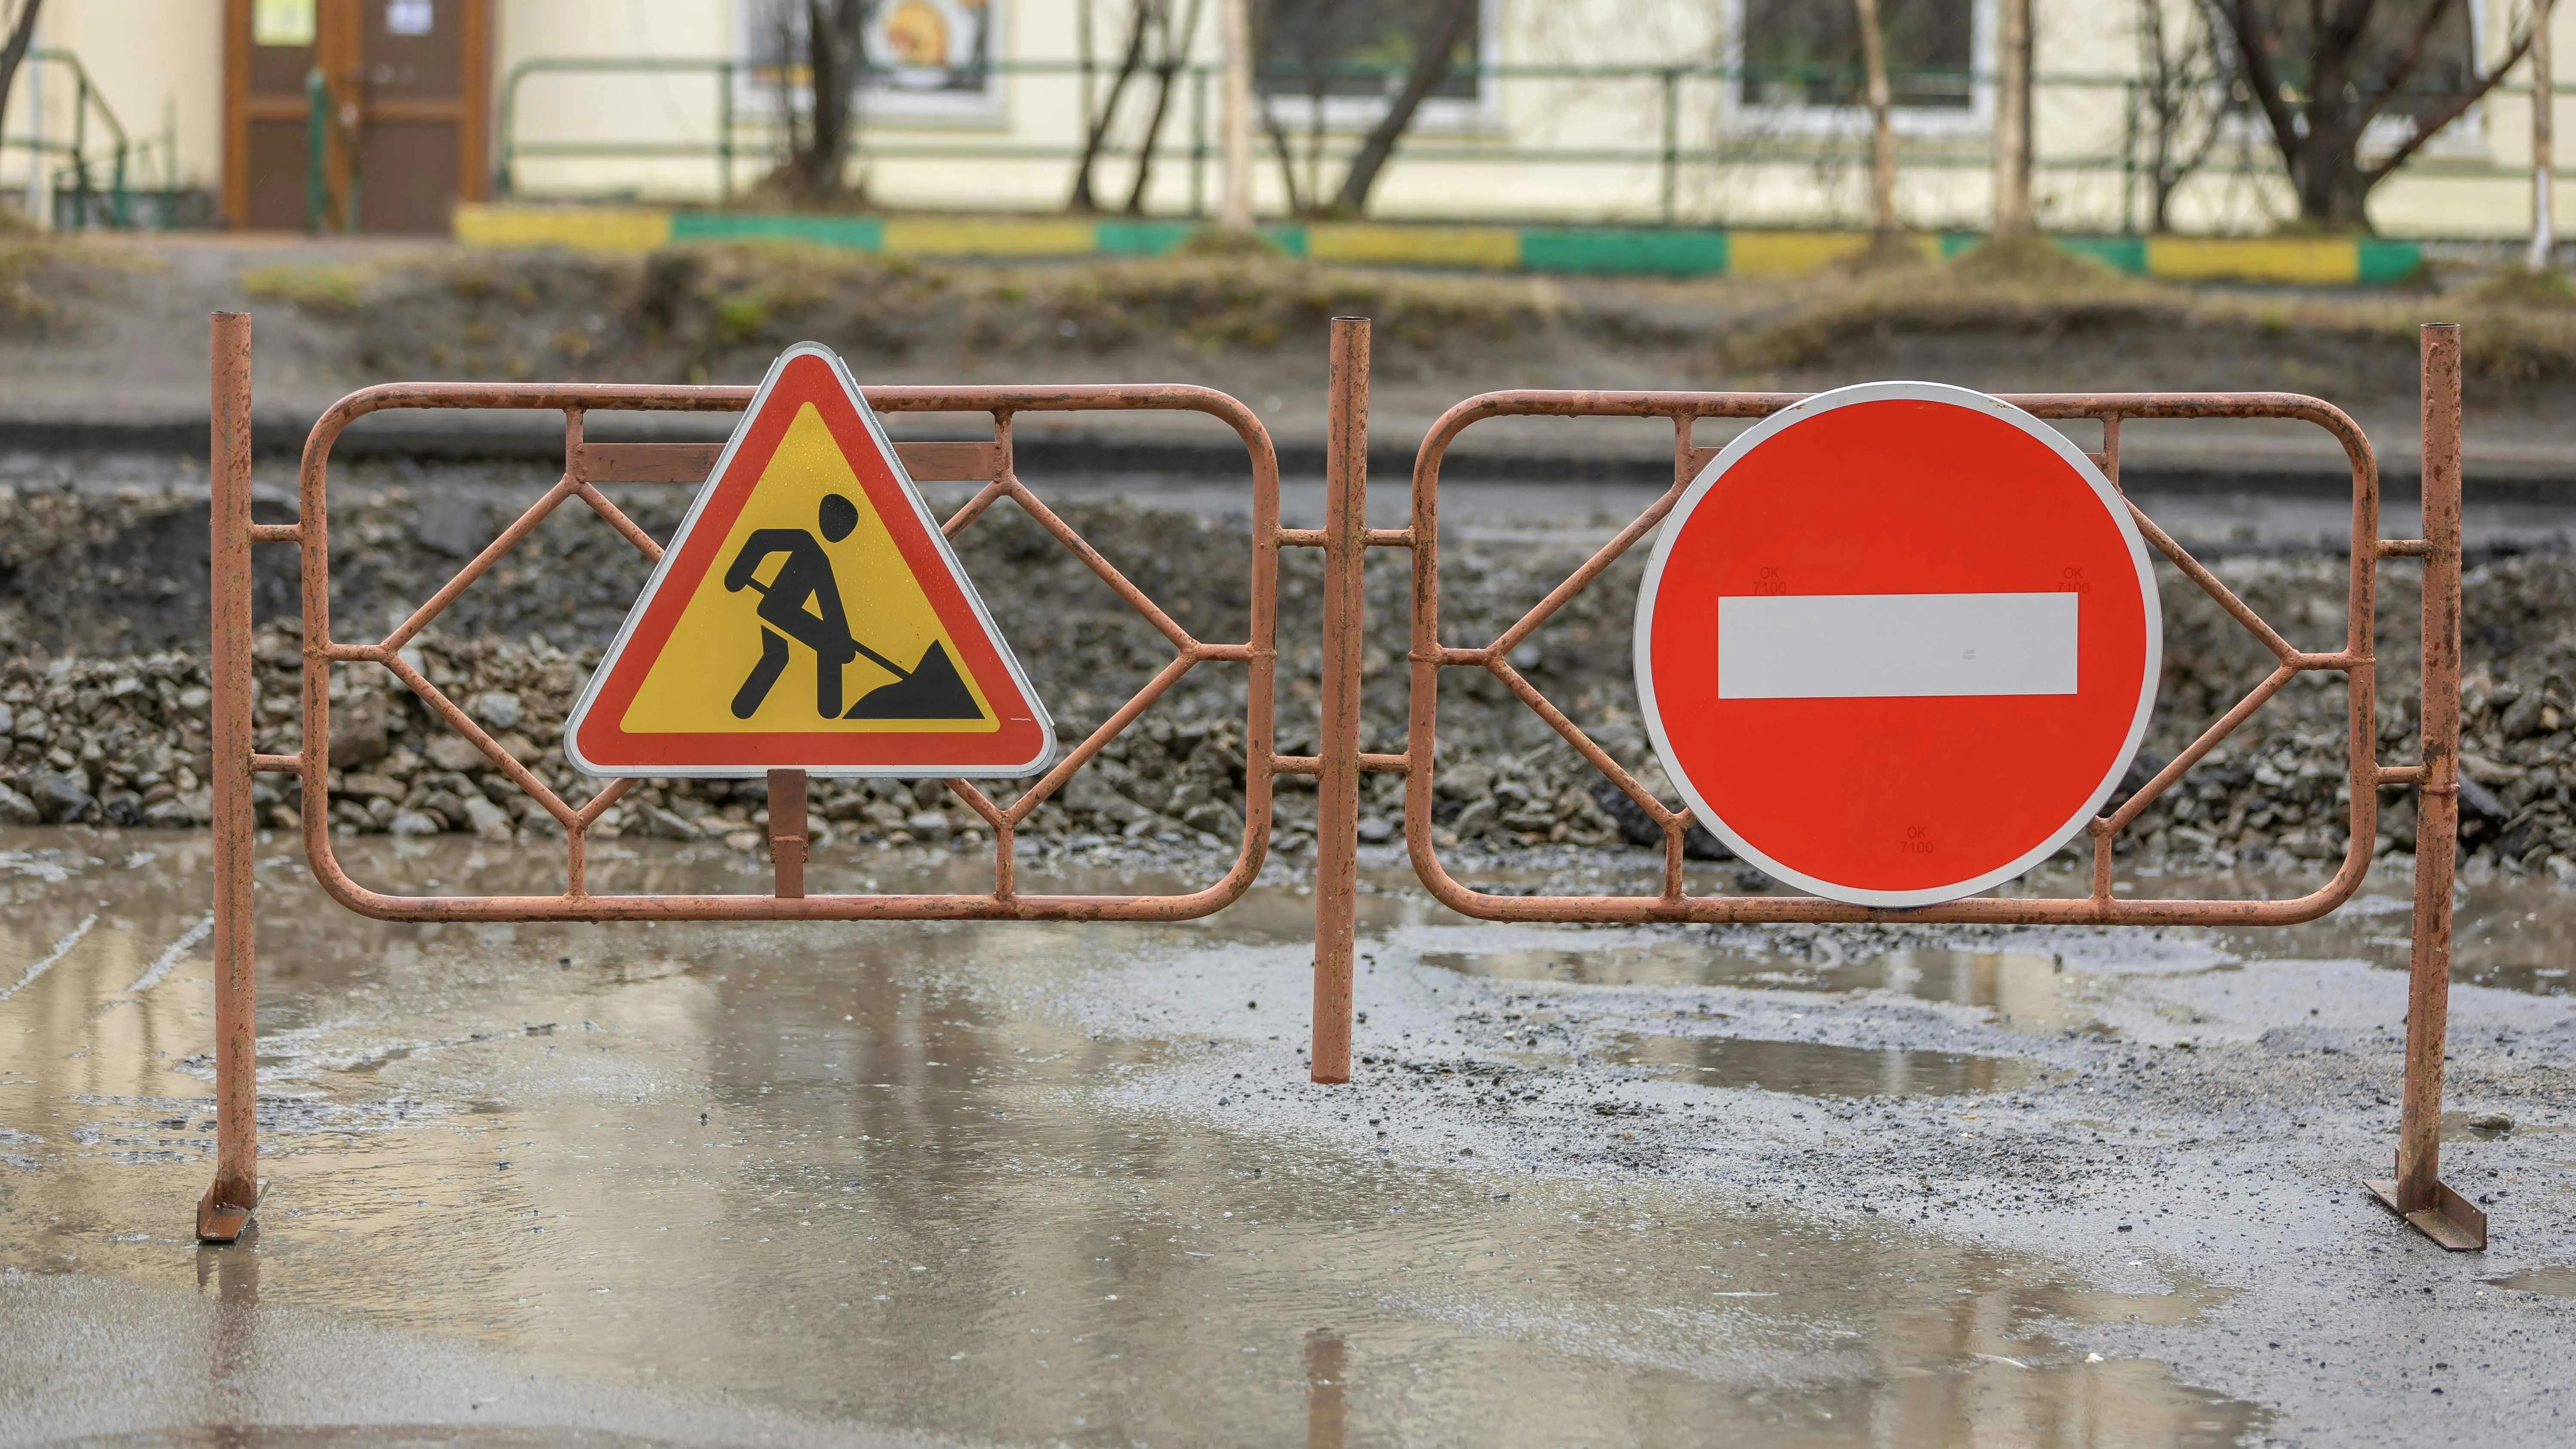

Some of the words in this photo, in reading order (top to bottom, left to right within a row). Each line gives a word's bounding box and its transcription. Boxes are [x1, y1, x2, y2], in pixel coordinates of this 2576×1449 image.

[1760, 566, 1779, 579] OK
[2064, 566, 2083, 579] OK
[1753, 582, 1786, 595] 7100
[2057, 582, 2090, 594] 7100
[1907, 826, 1926, 838] OK
[1900, 841, 1933, 854] 7100
